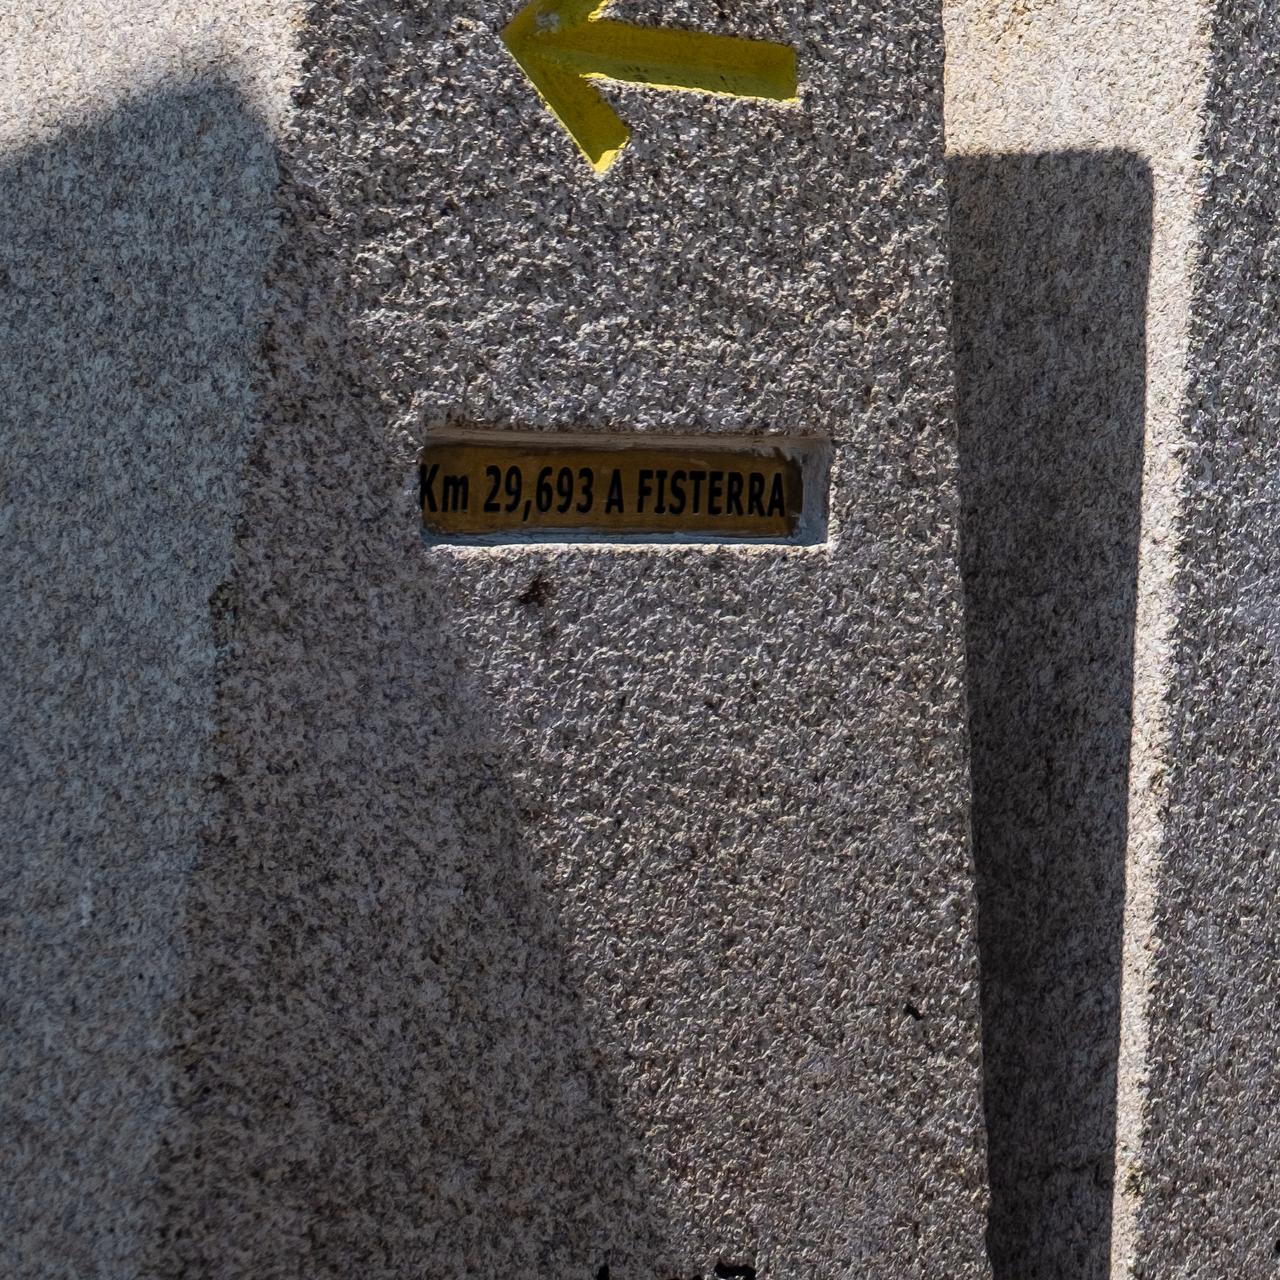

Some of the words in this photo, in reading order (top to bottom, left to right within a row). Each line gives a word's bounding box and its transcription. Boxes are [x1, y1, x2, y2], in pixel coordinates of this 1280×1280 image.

[419, 463, 469, 513] Km
[483, 464, 595, 522] 29,693
[604, 468, 625, 514] A
[637, 469, 786, 518] FISTERRA
